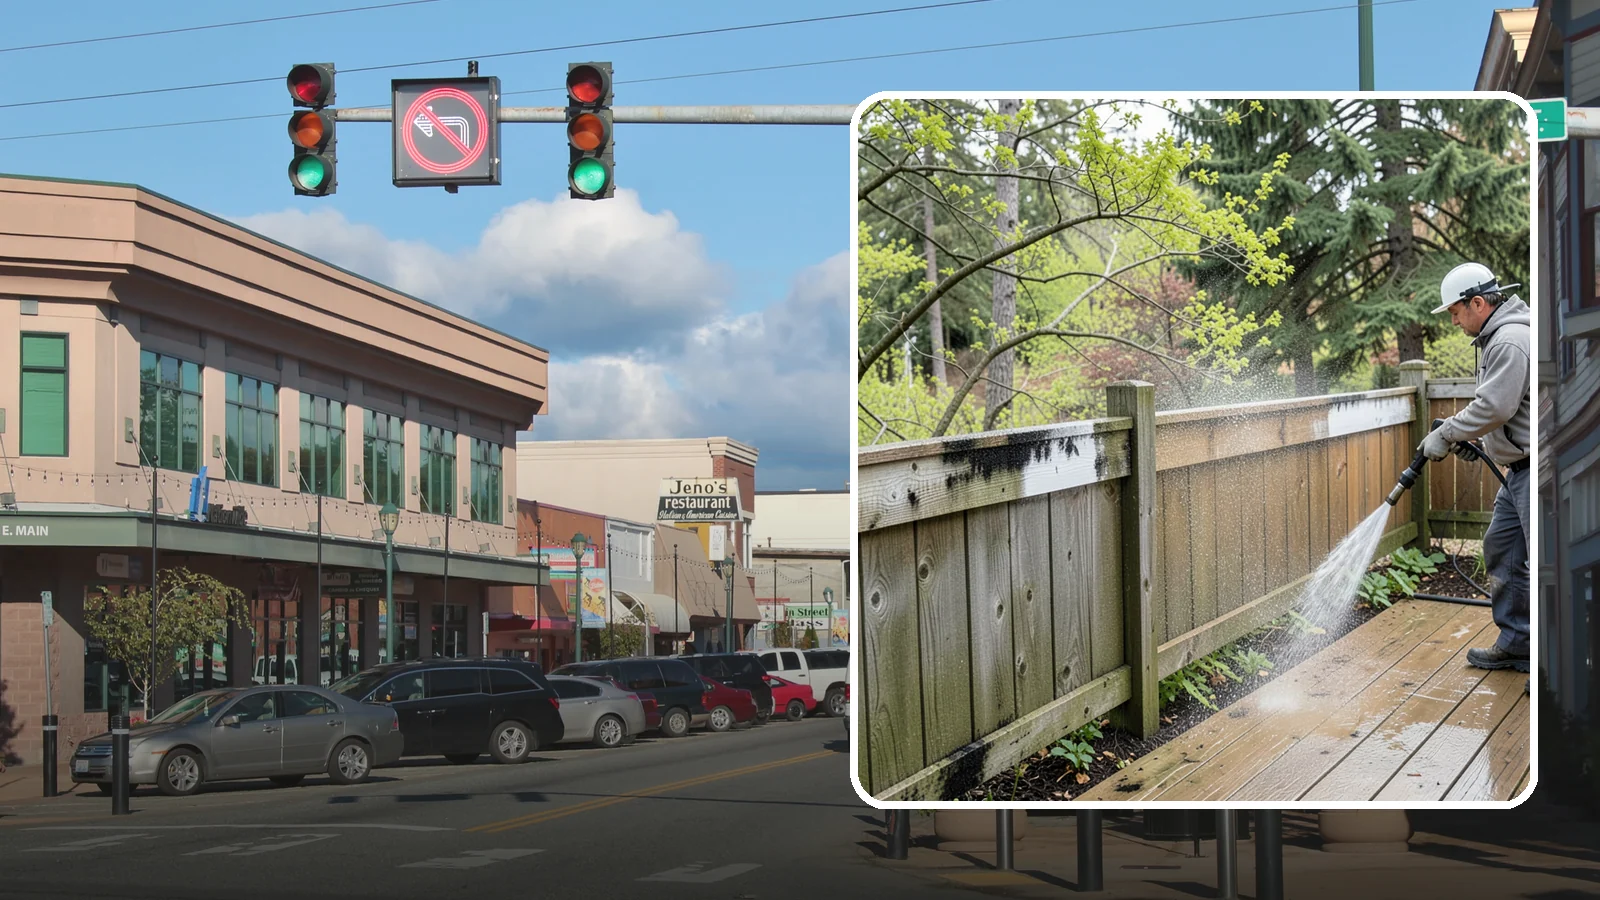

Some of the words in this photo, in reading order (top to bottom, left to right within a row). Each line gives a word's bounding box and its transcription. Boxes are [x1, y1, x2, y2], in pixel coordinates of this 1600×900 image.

[670, 480, 728, 494] Jeno's
[665, 496, 731, 509] restaurant
[658, 509, 682, 520] Italian
[686, 509, 715, 520] American
[715, 508, 738, 520] Cuisine
[2, 525, 13, 536] E.
[15, 525, 49, 537] MAIN
[797, 607, 829, 617] Street
